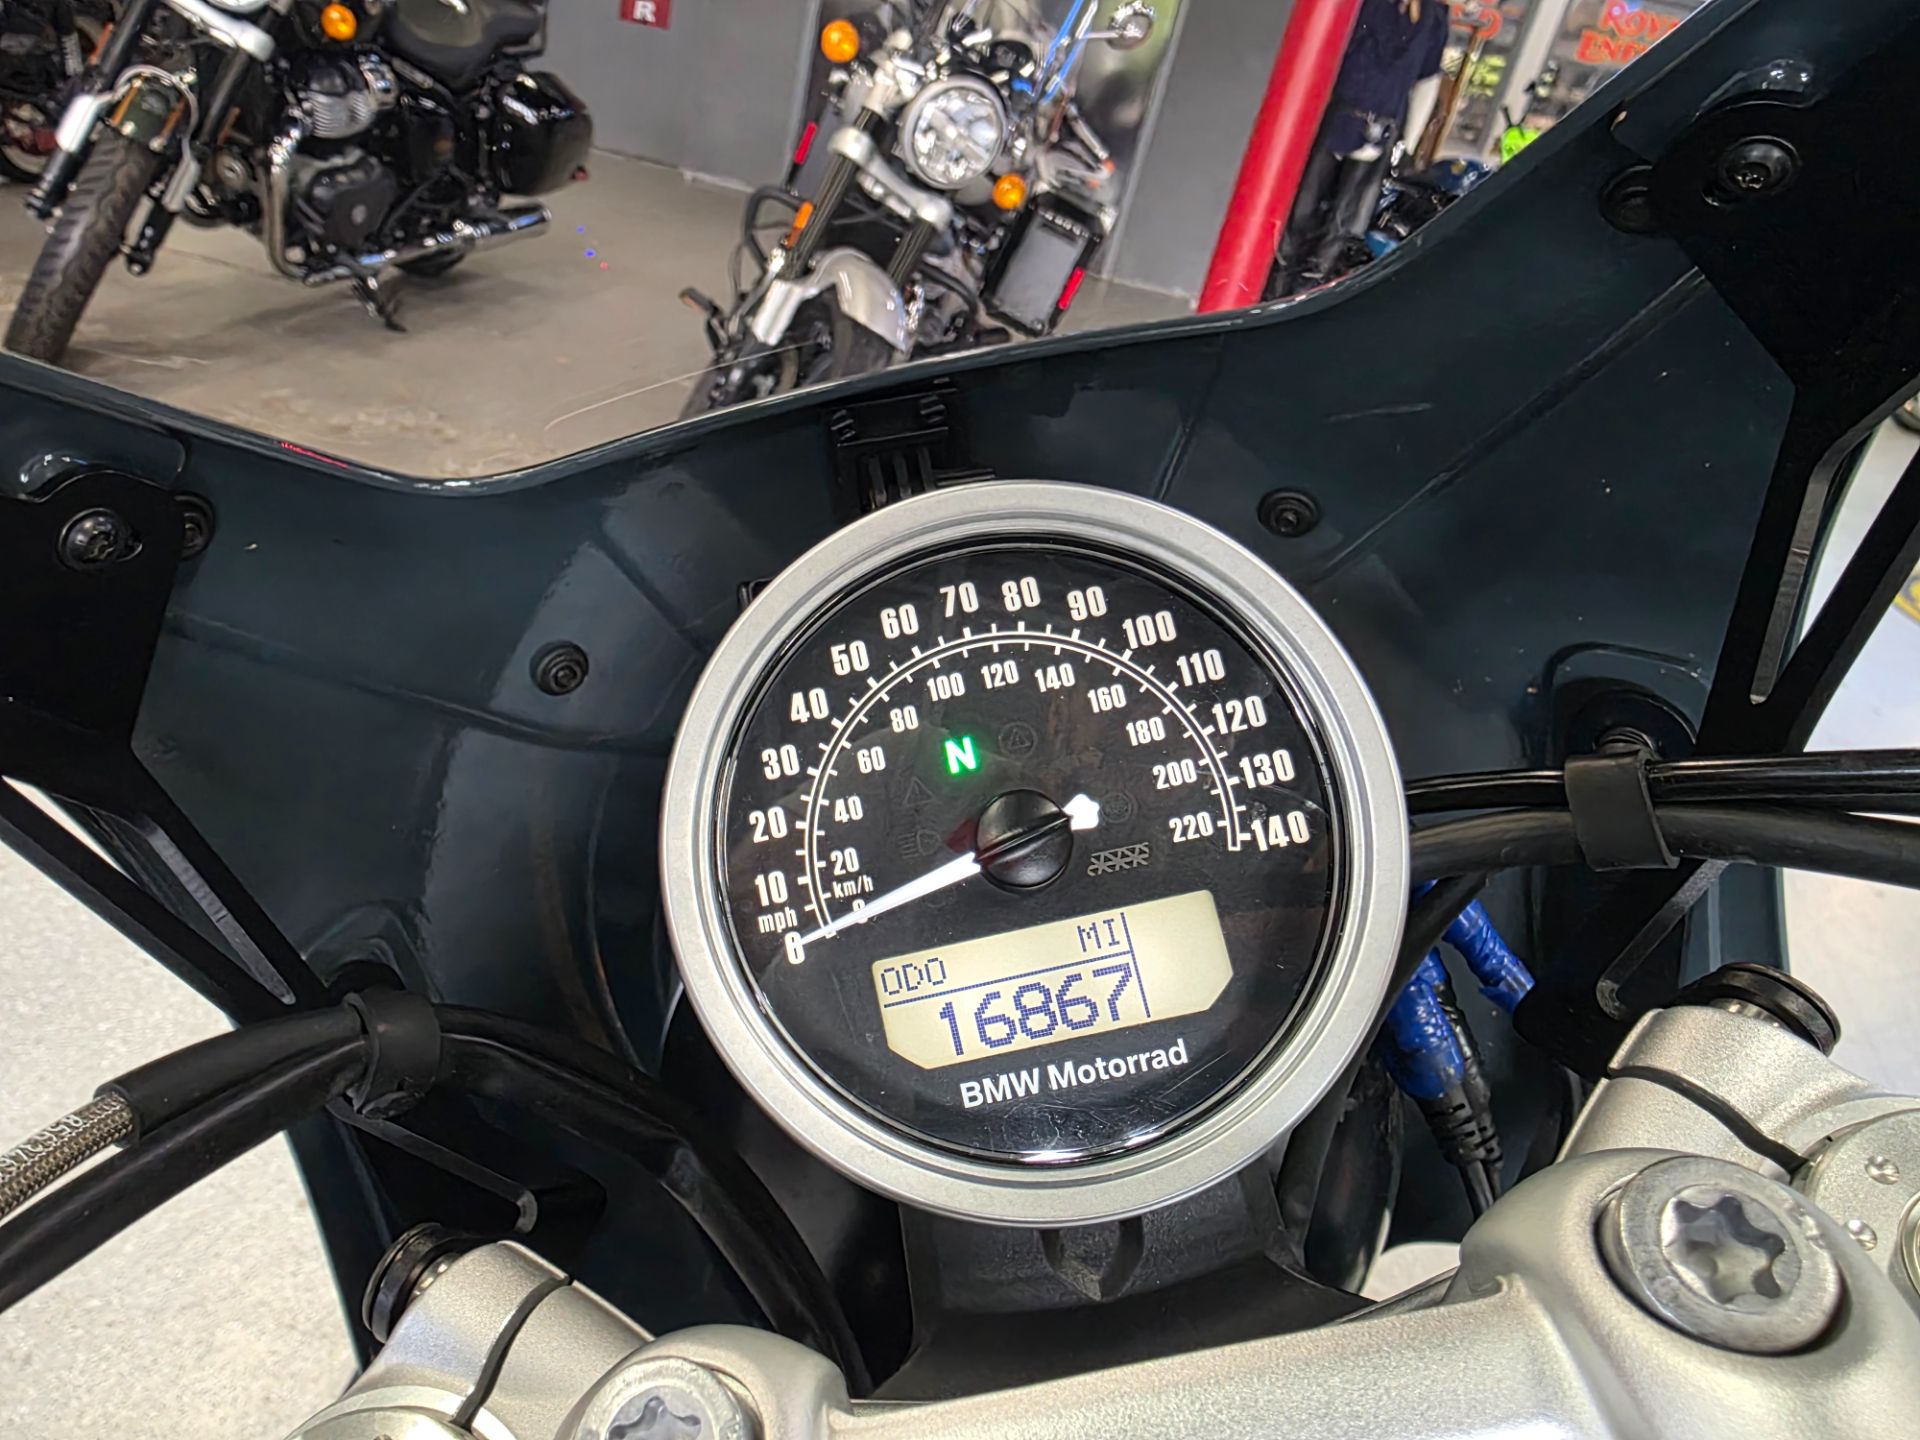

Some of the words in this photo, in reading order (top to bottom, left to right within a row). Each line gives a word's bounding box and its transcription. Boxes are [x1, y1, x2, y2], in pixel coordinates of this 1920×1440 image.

[940, 582, 979, 617] 70
[1002, 577, 1040, 611] 80
[1067, 586, 1106, 621] 90
[881, 604, 919, 639] 60
[1121, 610, 1177, 649] 100
[830, 640, 870, 676] 50
[981, 660, 1019, 689] 120
[1176, 649, 1226, 687] 110
[926, 672, 966, 702] 100
[1035, 663, 1075, 692] 140
[790, 687, 829, 723] 40
[1087, 684, 1126, 713] 160
[1212, 695, 1267, 735] 120
[890, 705, 919, 733] 80
[1125, 716, 1166, 747] 180
[762, 744, 800, 780] 30
[857, 746, 886, 773] 60
[945, 737, 977, 774] N
[1239, 749, 1295, 789] 130
[1152, 758, 1197, 790] 200
[749, 806, 787, 843] 20
[835, 795, 863, 823] 40
[1169, 812, 1214, 842] 220
[1251, 810, 1310, 852] 140
[829, 846, 860, 876] 20
[754, 870, 788, 907] 10
[832, 874, 874, 899] km/h
[757, 906, 798, 934] mph
[1077, 918, 1121, 953] MI
[880, 957, 948, 995] ODO
[939, 962, 1133, 1057] 16867
[959, 1067, 1041, 1109] BMW
[1047, 1038, 1190, 1092] Motorrad
